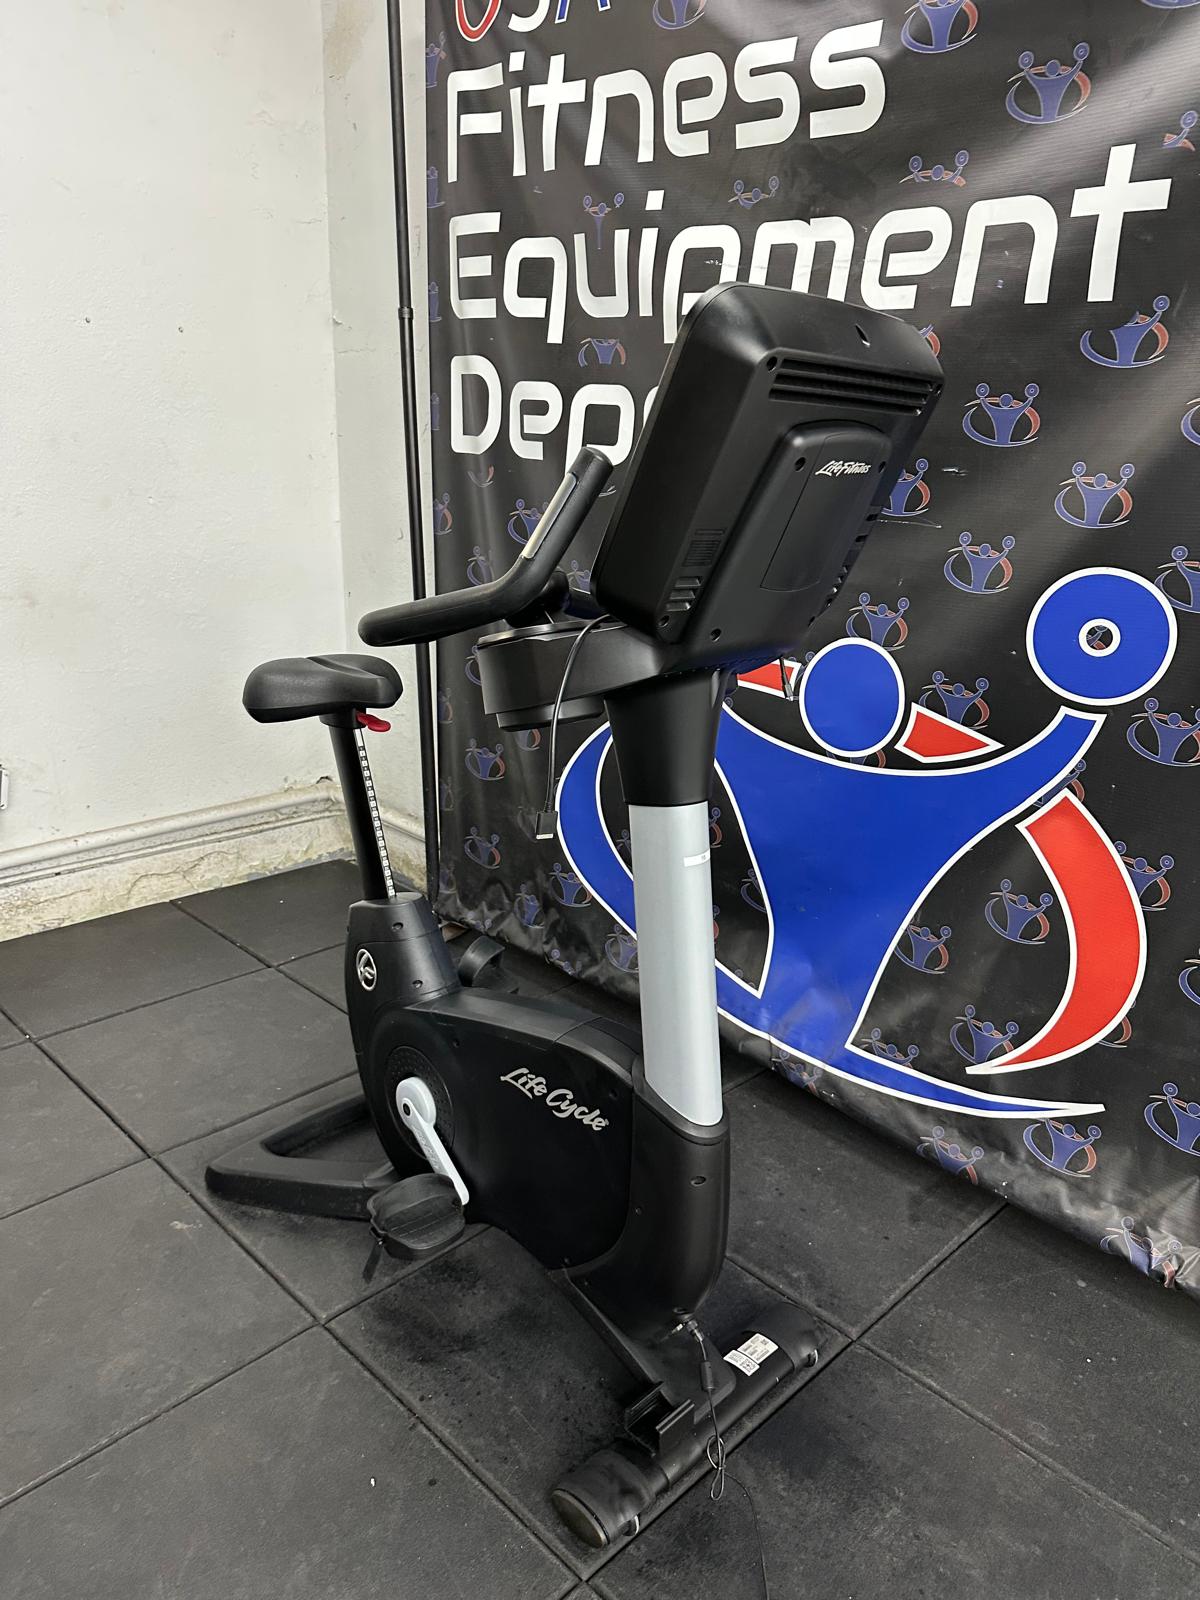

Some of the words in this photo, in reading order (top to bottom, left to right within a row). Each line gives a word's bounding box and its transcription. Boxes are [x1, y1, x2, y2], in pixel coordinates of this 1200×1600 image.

[447, 20, 886, 183] Fitness
[448, 143, 1173, 344] Equipment
[450, 354, 659, 478] Dep
[500, 1067, 547, 1099] Life
[546, 1088, 606, 1131] Cycle
